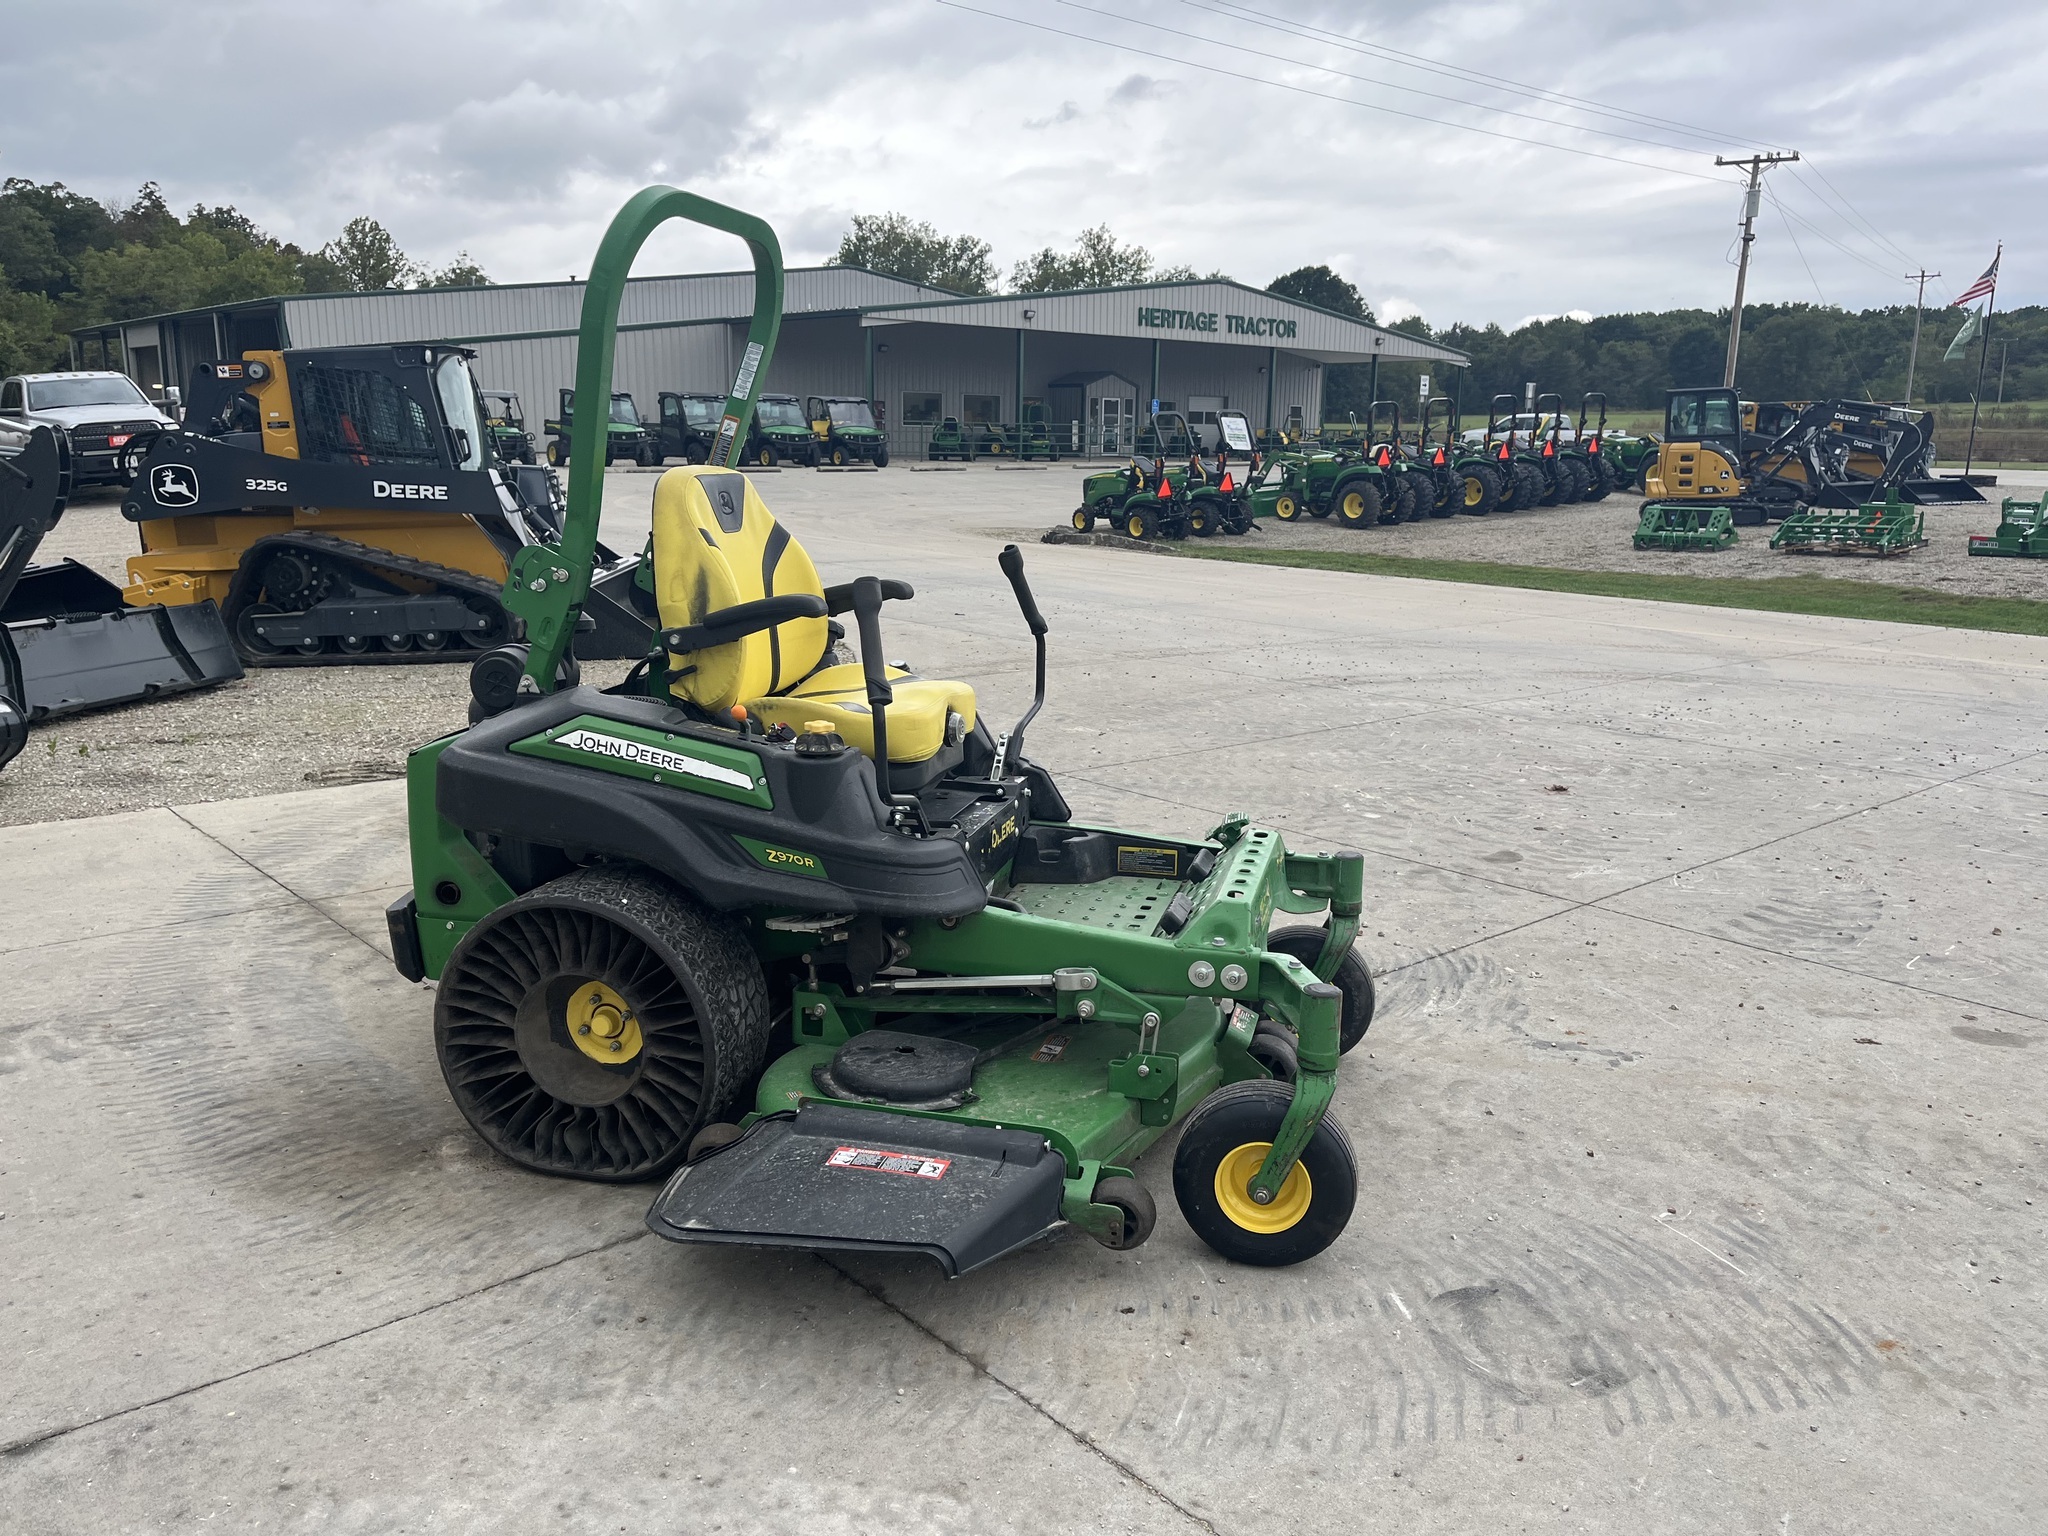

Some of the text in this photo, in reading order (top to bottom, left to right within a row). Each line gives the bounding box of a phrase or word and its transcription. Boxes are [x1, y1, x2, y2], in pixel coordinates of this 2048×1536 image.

[1138, 307, 1297, 338] HERITAGE TRACTOR
[1834, 412, 1860, 422] DEERE
[1853, 440, 1873, 449] DEERE
[245, 479, 288, 491] 325G
[373, 480, 448, 500] DEERE
[573, 733, 684, 770] JOHN DEERE
[766, 849, 815, 868] Z970R
